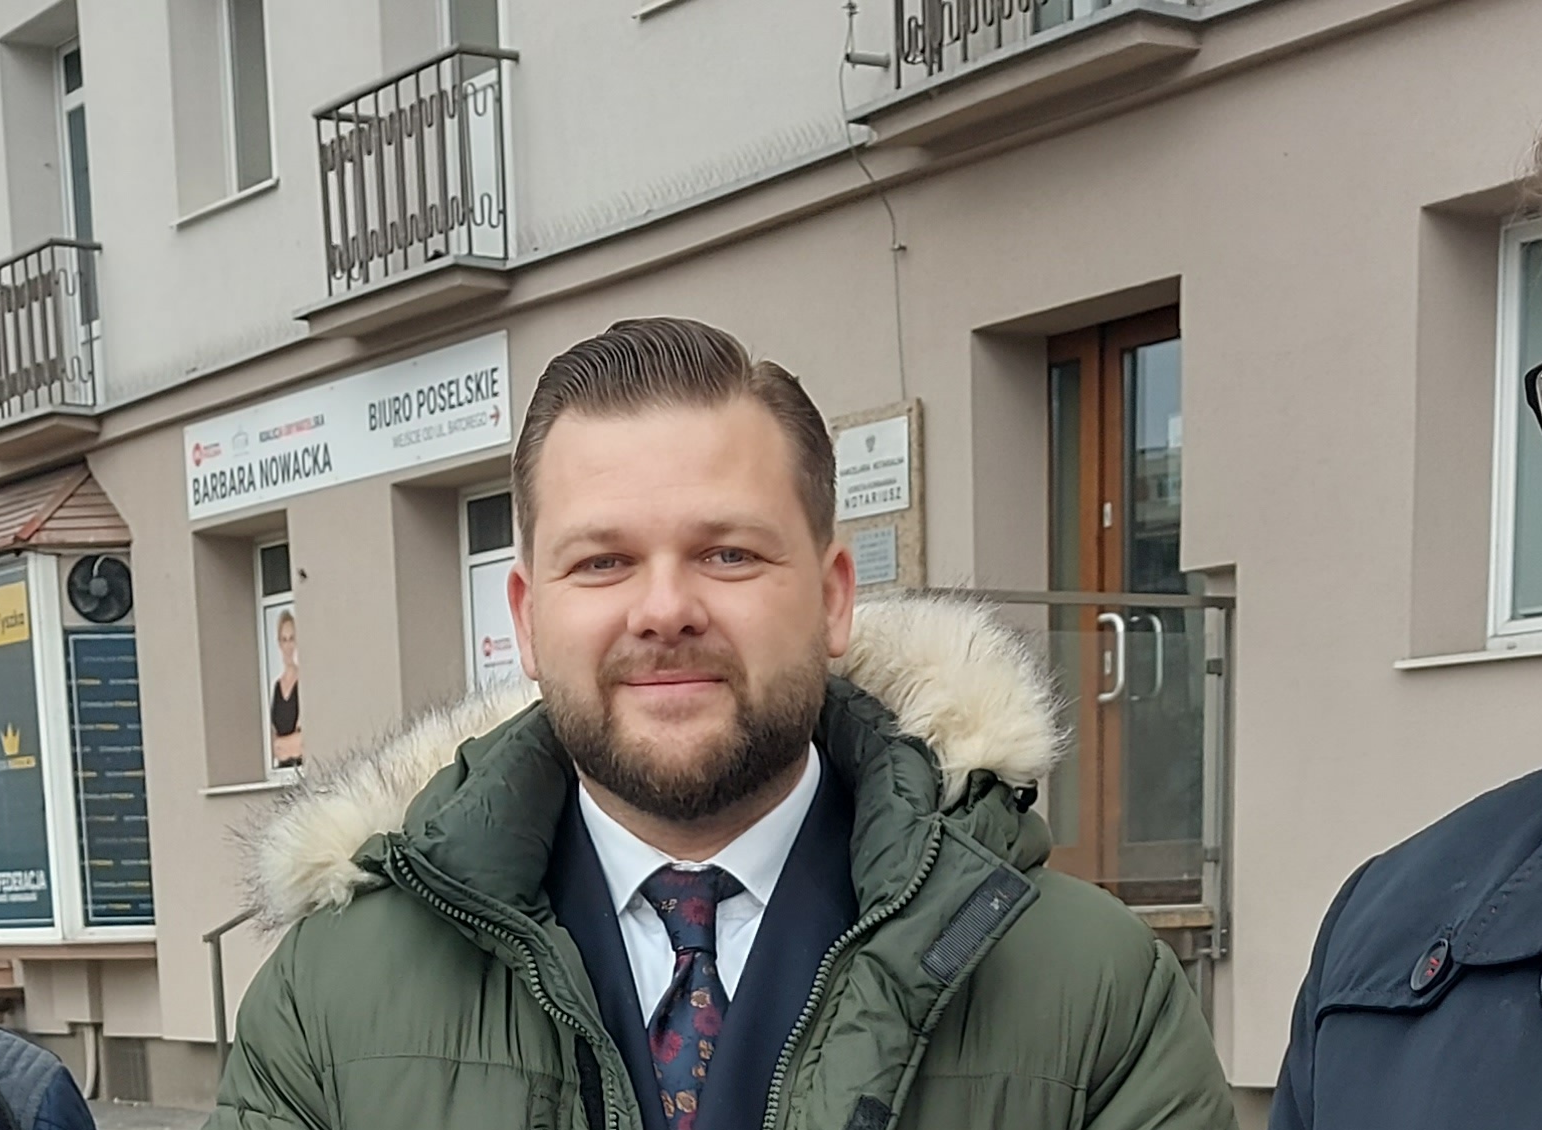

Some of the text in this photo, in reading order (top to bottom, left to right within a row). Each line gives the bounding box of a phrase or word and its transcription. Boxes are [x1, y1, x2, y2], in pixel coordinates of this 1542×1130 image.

[368, 366, 500, 432] BIURO POSELSKIE
[192, 442, 333, 506] BARBARA NOWACKA
[844, 486, 902, 509] NOTARIUSZ
